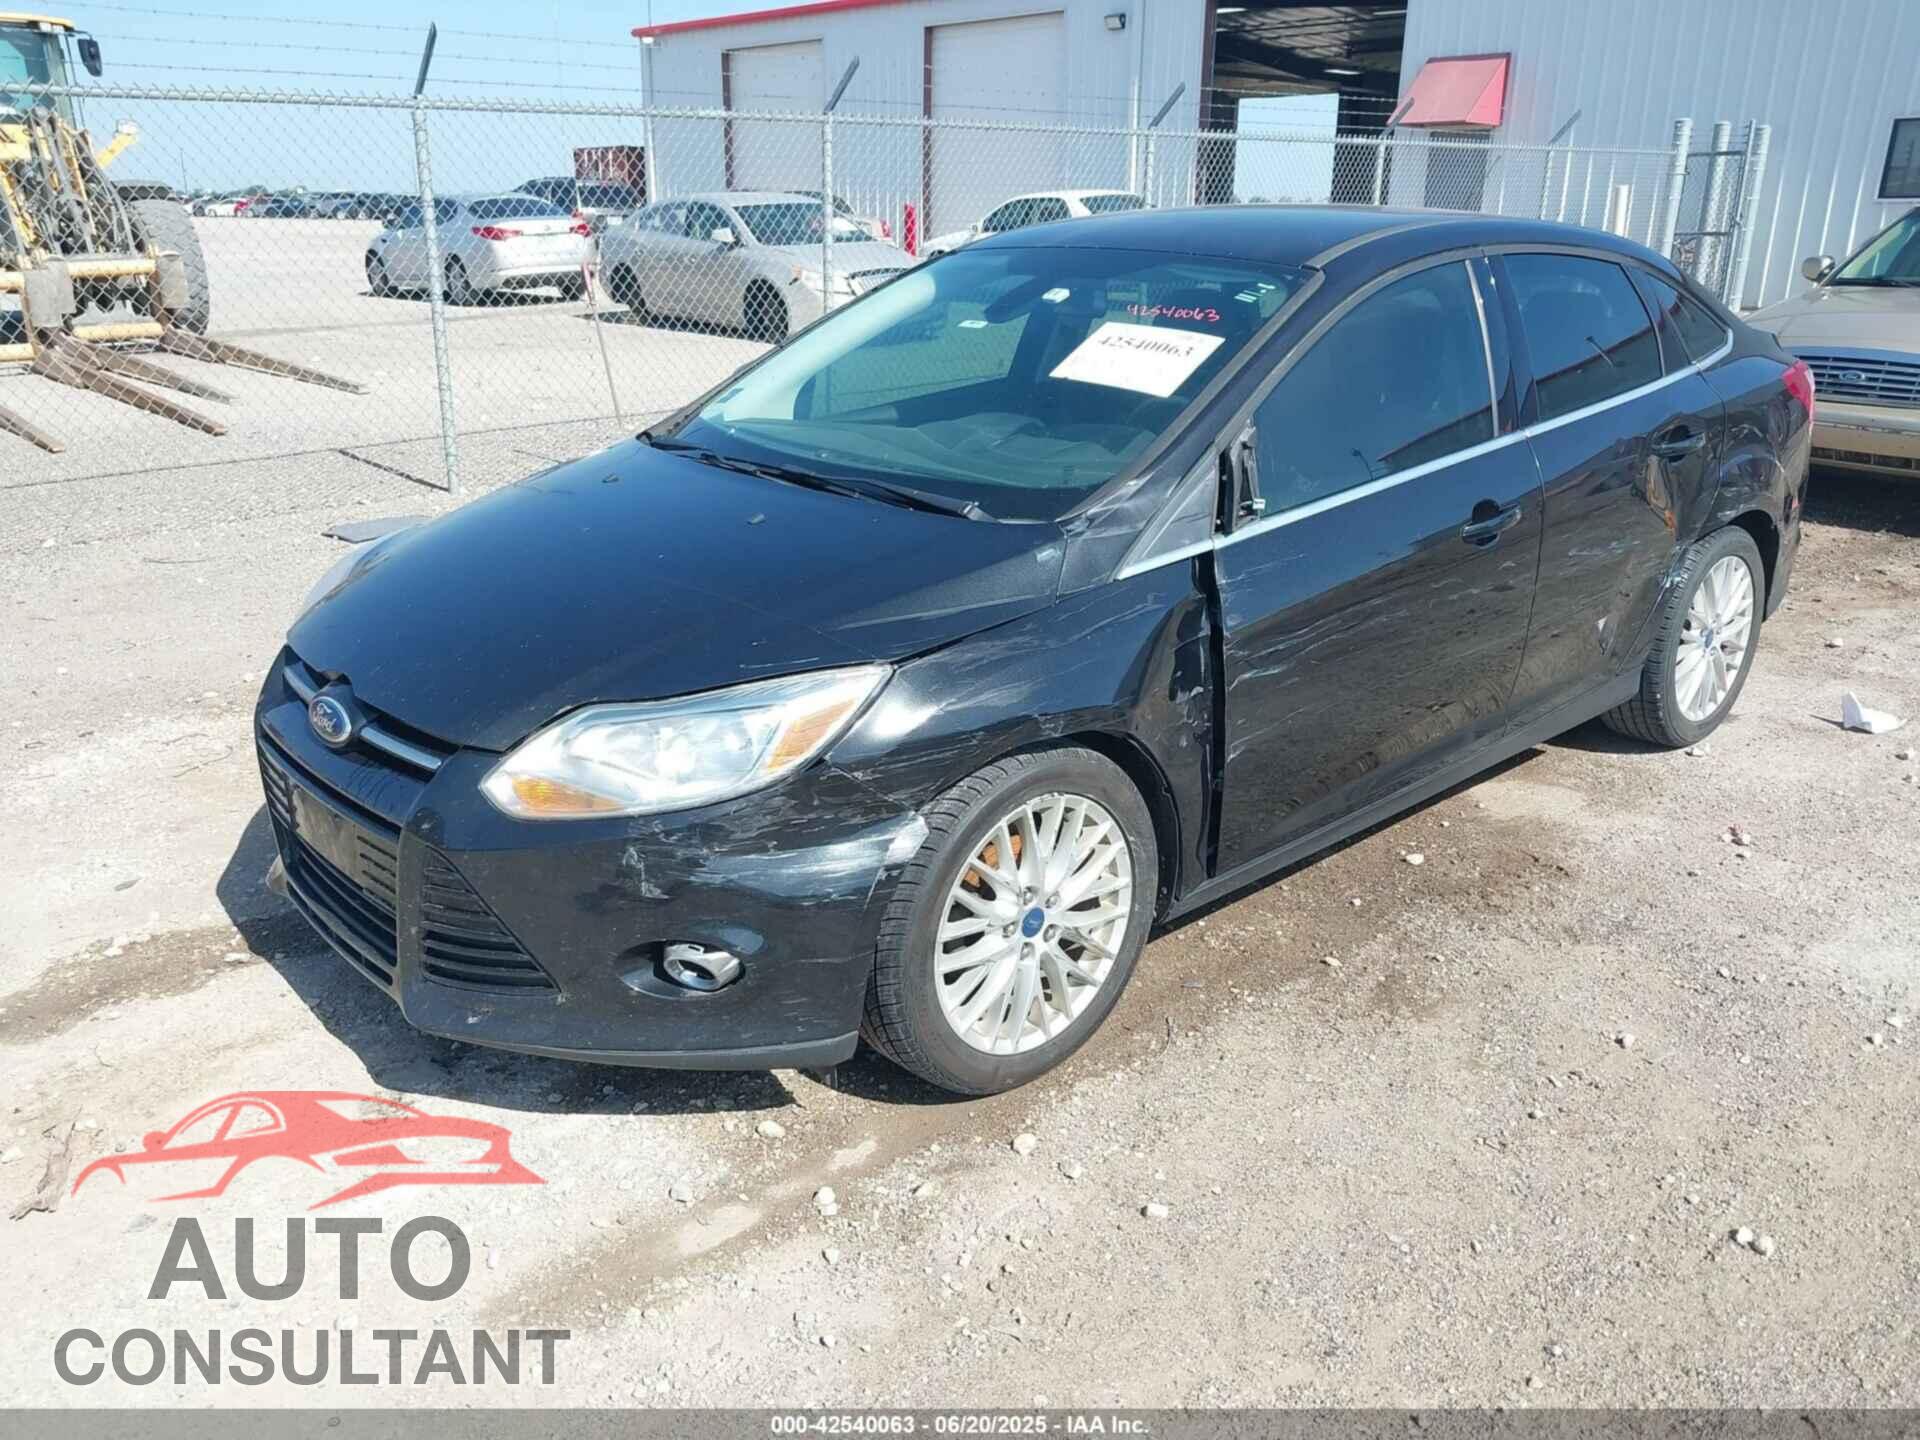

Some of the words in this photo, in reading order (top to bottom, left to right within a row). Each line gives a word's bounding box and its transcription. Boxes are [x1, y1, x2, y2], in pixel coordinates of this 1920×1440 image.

[1127, 304, 1220, 322] 42540063
[1098, 336, 1194, 357] 42540063
[313, 702, 337, 733] Ford
